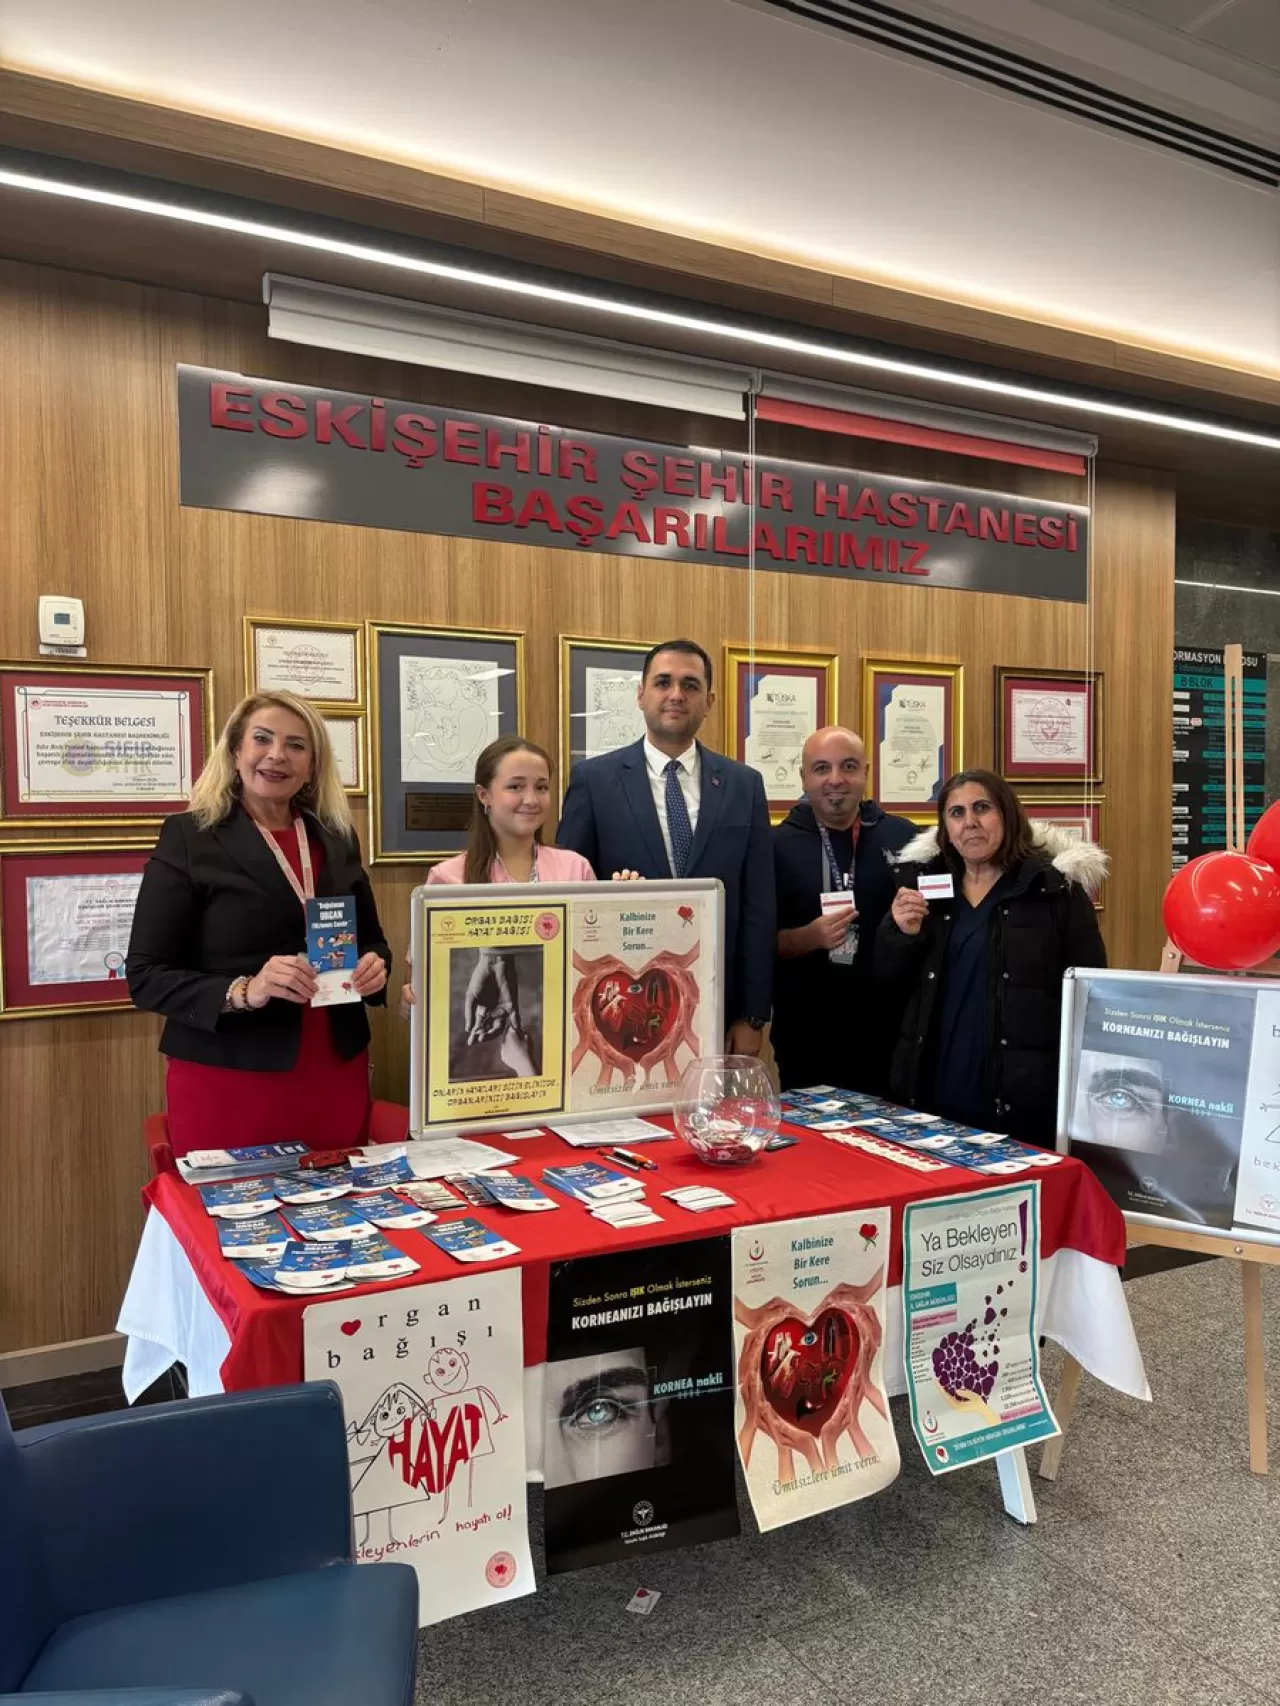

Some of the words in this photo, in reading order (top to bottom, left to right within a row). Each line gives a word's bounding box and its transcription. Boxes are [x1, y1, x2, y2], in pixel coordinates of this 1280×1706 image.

[209, 382, 598, 483] ESKİŞEHİR
[619, 450, 794, 511] ŞEHİR
[813, 479, 1078, 553] HASTANESİ
[472, 482, 930, 576] BAŞARILARIMIZ
[1181, 677, 1187, 686] B
[1188, 677, 1214, 688] BLOK
[54, 714, 112, 727] TEŞEKKÜR
[114, 716, 156, 727] BELGESİ
[619, 912, 656, 922] Kalbinize
[622, 926, 633, 936] Bir
[635, 926, 654, 935] Kere
[1104, 1007, 1128, 1017] Sizden
[1168, 1015, 1193, 1028] Olmak
[1101, 1021, 1164, 1039] KORNEANIZI
[1167, 1030, 1230, 1049] BAĞIŞLAYIN
[1168, 1093, 1206, 1109] KORNEA
[1208, 1101, 1234, 1114] nakli
[791, 1236, 834, 1252] Kalbinize
[921, 1231, 942, 1252] Ya
[946, 1221, 1018, 1248] Bekleyen
[793, 1258, 808, 1270] Bir
[809, 1256, 831, 1268] Kere
[921, 1260, 944, 1277] Siz
[948, 1247, 1017, 1272] Olsaydınız
[572, 1294, 602, 1307] Sizden
[604, 1291, 628, 1302] Sonra
[629, 1286, 645, 1299] IŞIK
[646, 1281, 674, 1294] Olmak
[675, 1275, 712, 1289] İsterseniz
[792, 1275, 829, 1290] Sorun...
[571, 1304, 644, 1330] KORNEANIZI
[646, 1292, 713, 1316] BAĞIŞLAYIN
[653, 1377, 694, 1395] KORNEA
[696, 1371, 723, 1387] nakli
[388, 1403, 483, 1494] HAYAT
[495, 1503, 513, 1521] ol!
